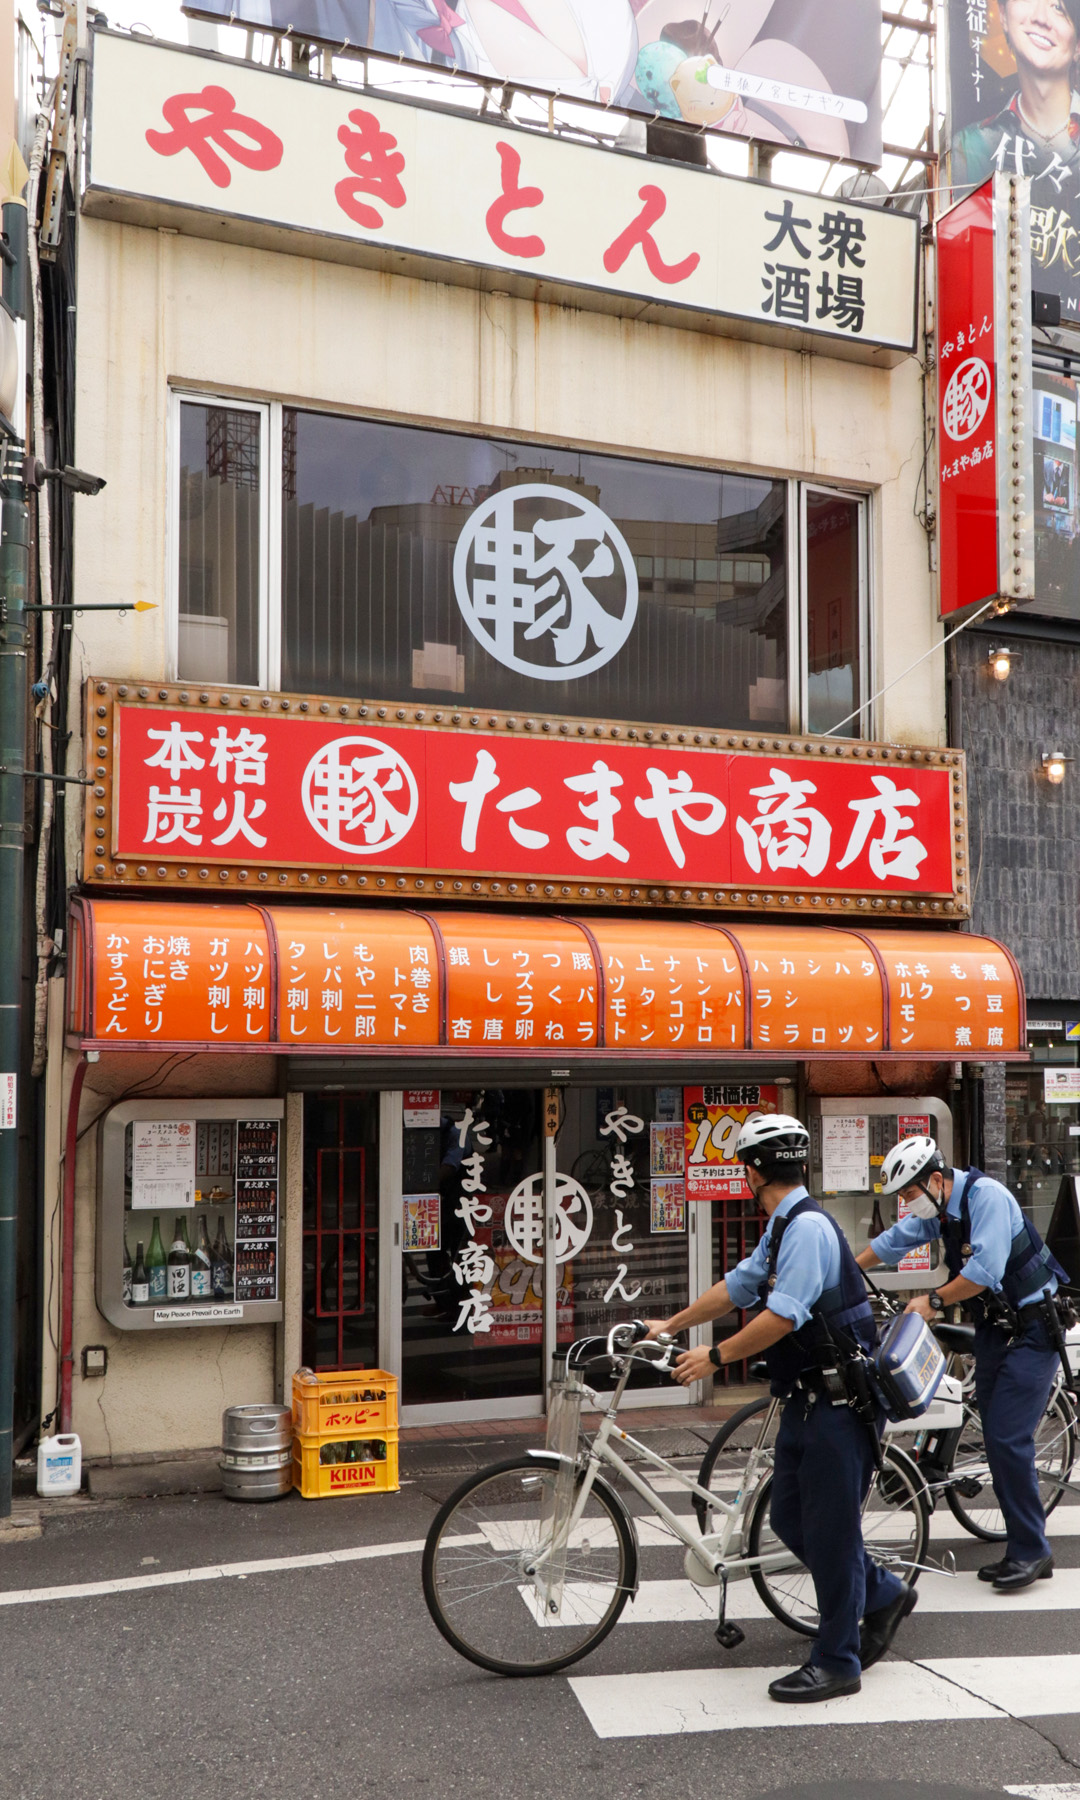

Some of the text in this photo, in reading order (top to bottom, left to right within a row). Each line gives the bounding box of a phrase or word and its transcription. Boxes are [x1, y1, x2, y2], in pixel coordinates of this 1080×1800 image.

[971, 36, 984, 102] オーナー
[145, 85, 700, 285] やきとん
[990, 132, 1080, 197] 代々
[763, 200, 866, 269] 大衆
[762, 263, 866, 333] 酒場
[941, 315, 993, 359] やきとん
[942, 440, 993, 483] たまや商店
[455, 484, 637, 680] 豚
[143, 721, 269, 786] 本格
[302, 736, 419, 854] 豚
[143, 785, 268, 849] 炭火
[449, 749, 928, 880] たまや商店
[105, 933, 130, 1033] かすうどん
[142, 935, 167, 1033] おにぎり
[167, 935, 191, 981] 焼き
[207, 937, 230, 1034] ガツ刺し
[242, 942, 265, 1035] ハツ刺し
[287, 941, 309, 1036] タン刺し
[321, 942, 343, 1036] レバ刺し
[354, 943, 376, 1037] もや二郎
[409, 945, 431, 1013] 肉巻き
[449, 946, 472, 1039] 銀杏
[483, 949, 504, 1040] しし唐
[512, 950, 534, 1040] ウズラ卵
[542, 953, 565, 1041] つくね
[571, 952, 594, 1042] 豚バラ
[607, 956, 626, 1041] ハツモト
[635, 954, 656, 1042] 上タン
[664, 955, 684, 1042] ナンコツ
[696, 956, 713, 1042] トントロ
[914, 962, 934, 1000] キク
[390, 967, 407, 1037] トマト
[722, 958, 742, 1043] レバー
[753, 959, 772, 1042] ハラミ
[779, 958, 800, 1043] カシラ
[808, 959, 826, 1043] シロ
[835, 962, 854, 1043] ハツ
[861, 961, 879, 1043] タン
[895, 962, 915, 1044] ホルモン
[950, 963, 972, 1046] もつ煮
[981, 963, 1004, 1046] 煮豆腐
[689, 1111, 765, 1164] 19
[703, 1086, 761, 1106] 新価格
[673, 1127, 684, 1171] 生ビール
[776, 1149, 807, 1159] POLICE
[417, 1199, 427, 1246] ハイボール
[428, 1198, 440, 1246] 生ビール
[453, 1108, 494, 1334] たまや商店
[600, 1106, 644, 1303] やきとん
[673, 1183, 683, 1228] 生ビール
[156, 1311, 169, 1319] May
[171, 1310, 190, 1318] Peace
[192, 1309, 212, 1317] Prevail
[326, 1408, 380, 1426] ホッピー
[330, 1466, 376, 1483] KIRIN
